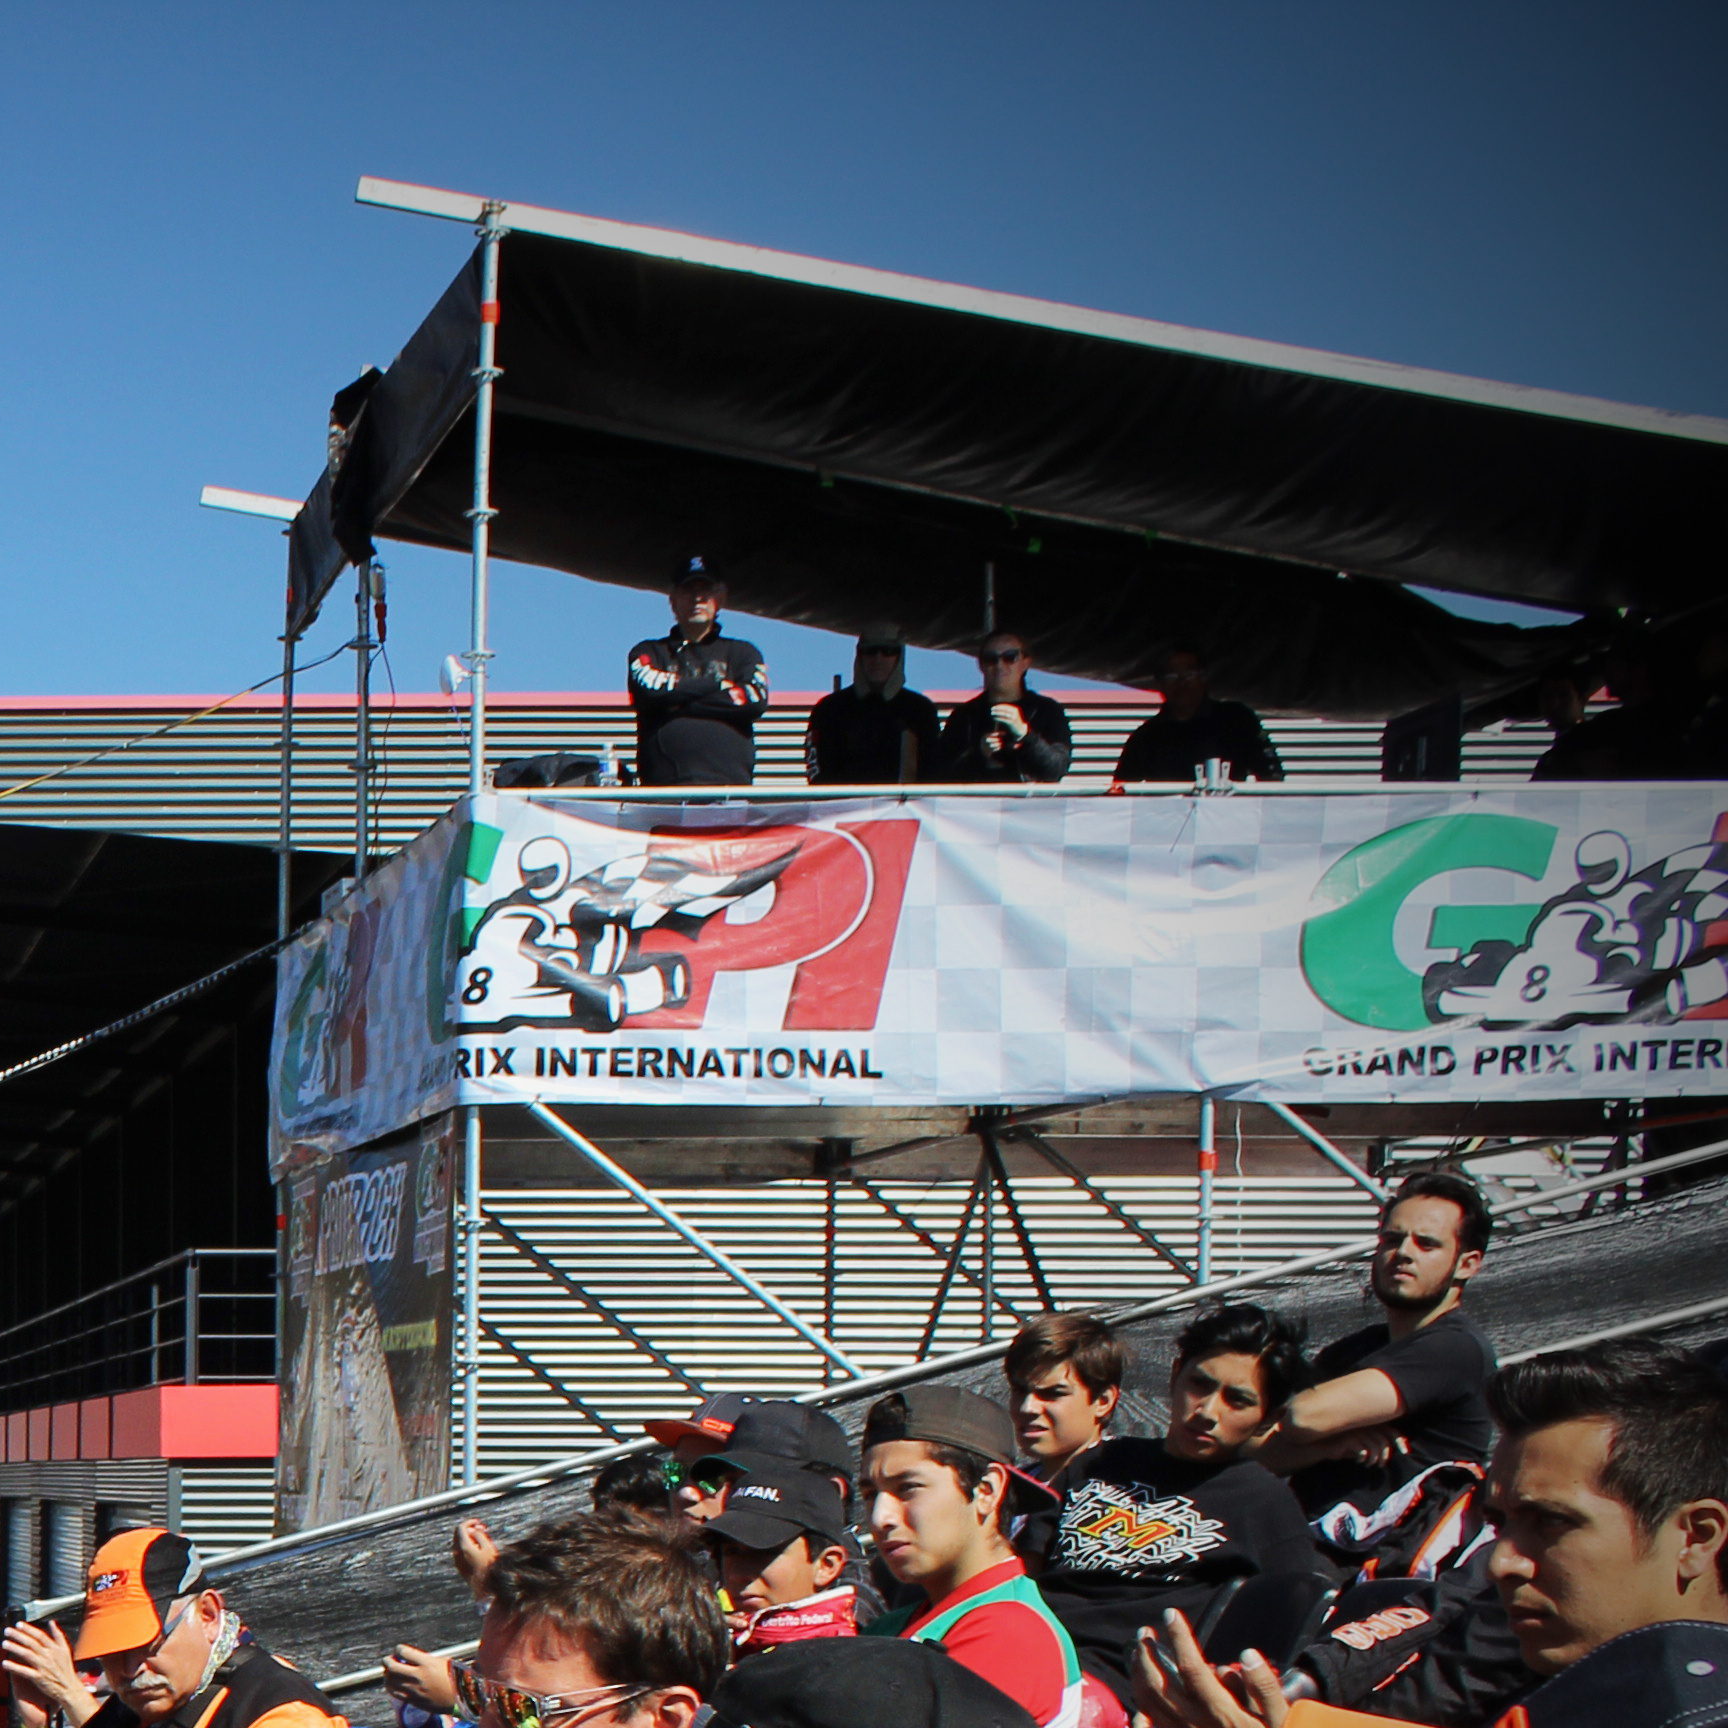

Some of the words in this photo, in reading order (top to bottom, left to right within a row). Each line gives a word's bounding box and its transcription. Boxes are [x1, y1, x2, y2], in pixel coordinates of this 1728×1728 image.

[462, 966, 493, 1005] 8
[1520, 964, 1551, 1003] 8
[454, 1046, 517, 1081] RIX
[535, 1046, 884, 1081] INTERNATIONAL
[1303, 1044, 1457, 1077] GRAND
[1473, 1042, 1576, 1077] PRIX
[1593, 1037, 1728, 1073] INTER
